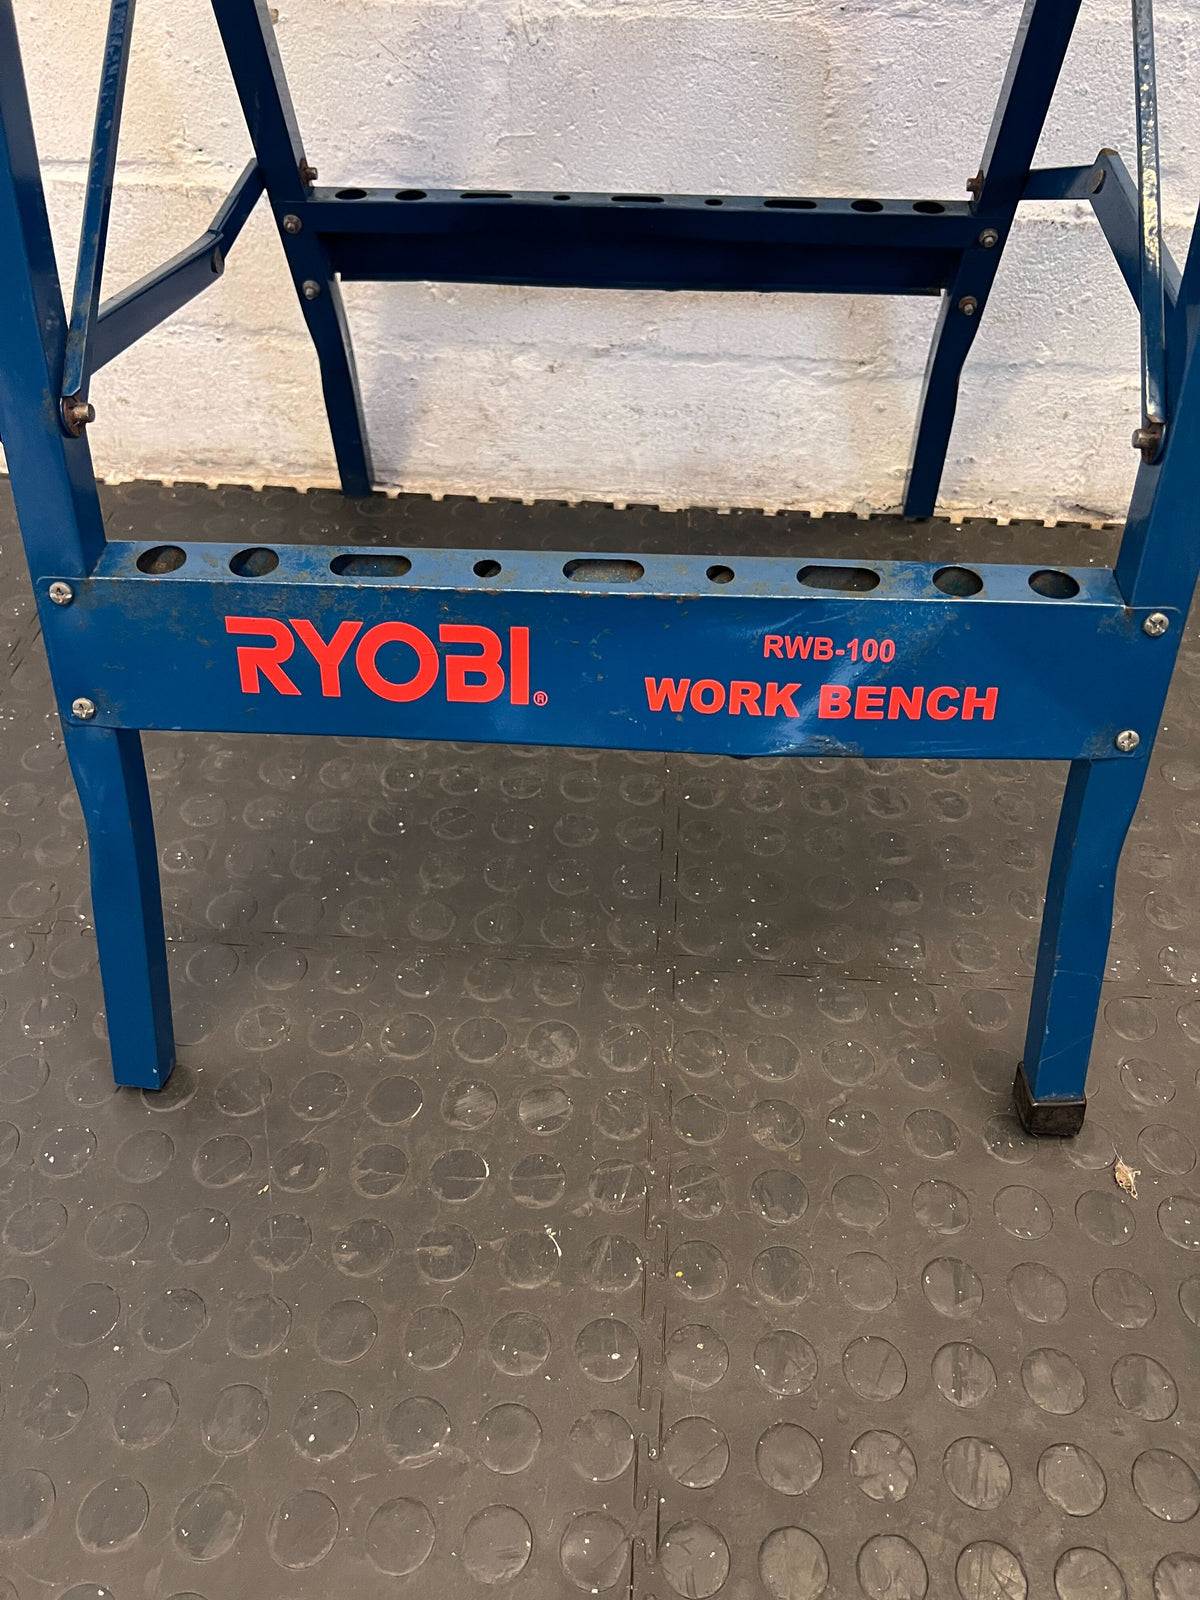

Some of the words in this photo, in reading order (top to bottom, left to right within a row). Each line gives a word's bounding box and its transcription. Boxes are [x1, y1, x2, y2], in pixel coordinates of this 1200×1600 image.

[224, 615, 530, 706] RYOBI
[763, 634, 896, 663] RWB-100
[644, 677, 802, 718] WORK
[818, 684, 999, 721] BENCH
